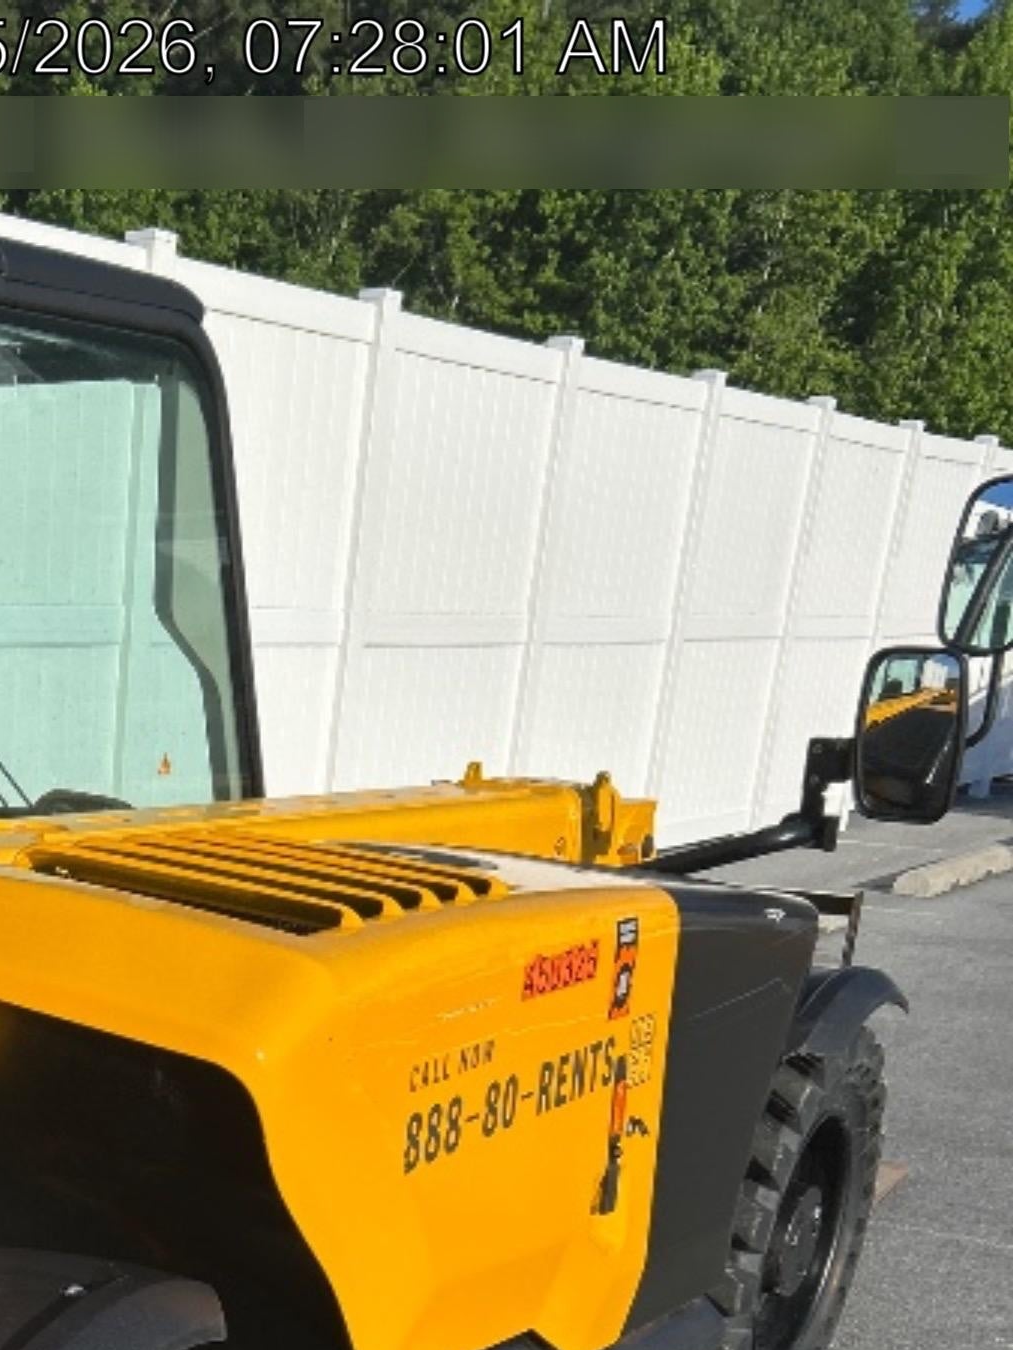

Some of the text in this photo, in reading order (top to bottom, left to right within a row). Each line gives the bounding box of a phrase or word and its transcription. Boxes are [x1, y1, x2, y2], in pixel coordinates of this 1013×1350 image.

[402, 1035, 617, 1176] 888-80-RENTS
[408, 1039, 496, 1094] CALL NOW
